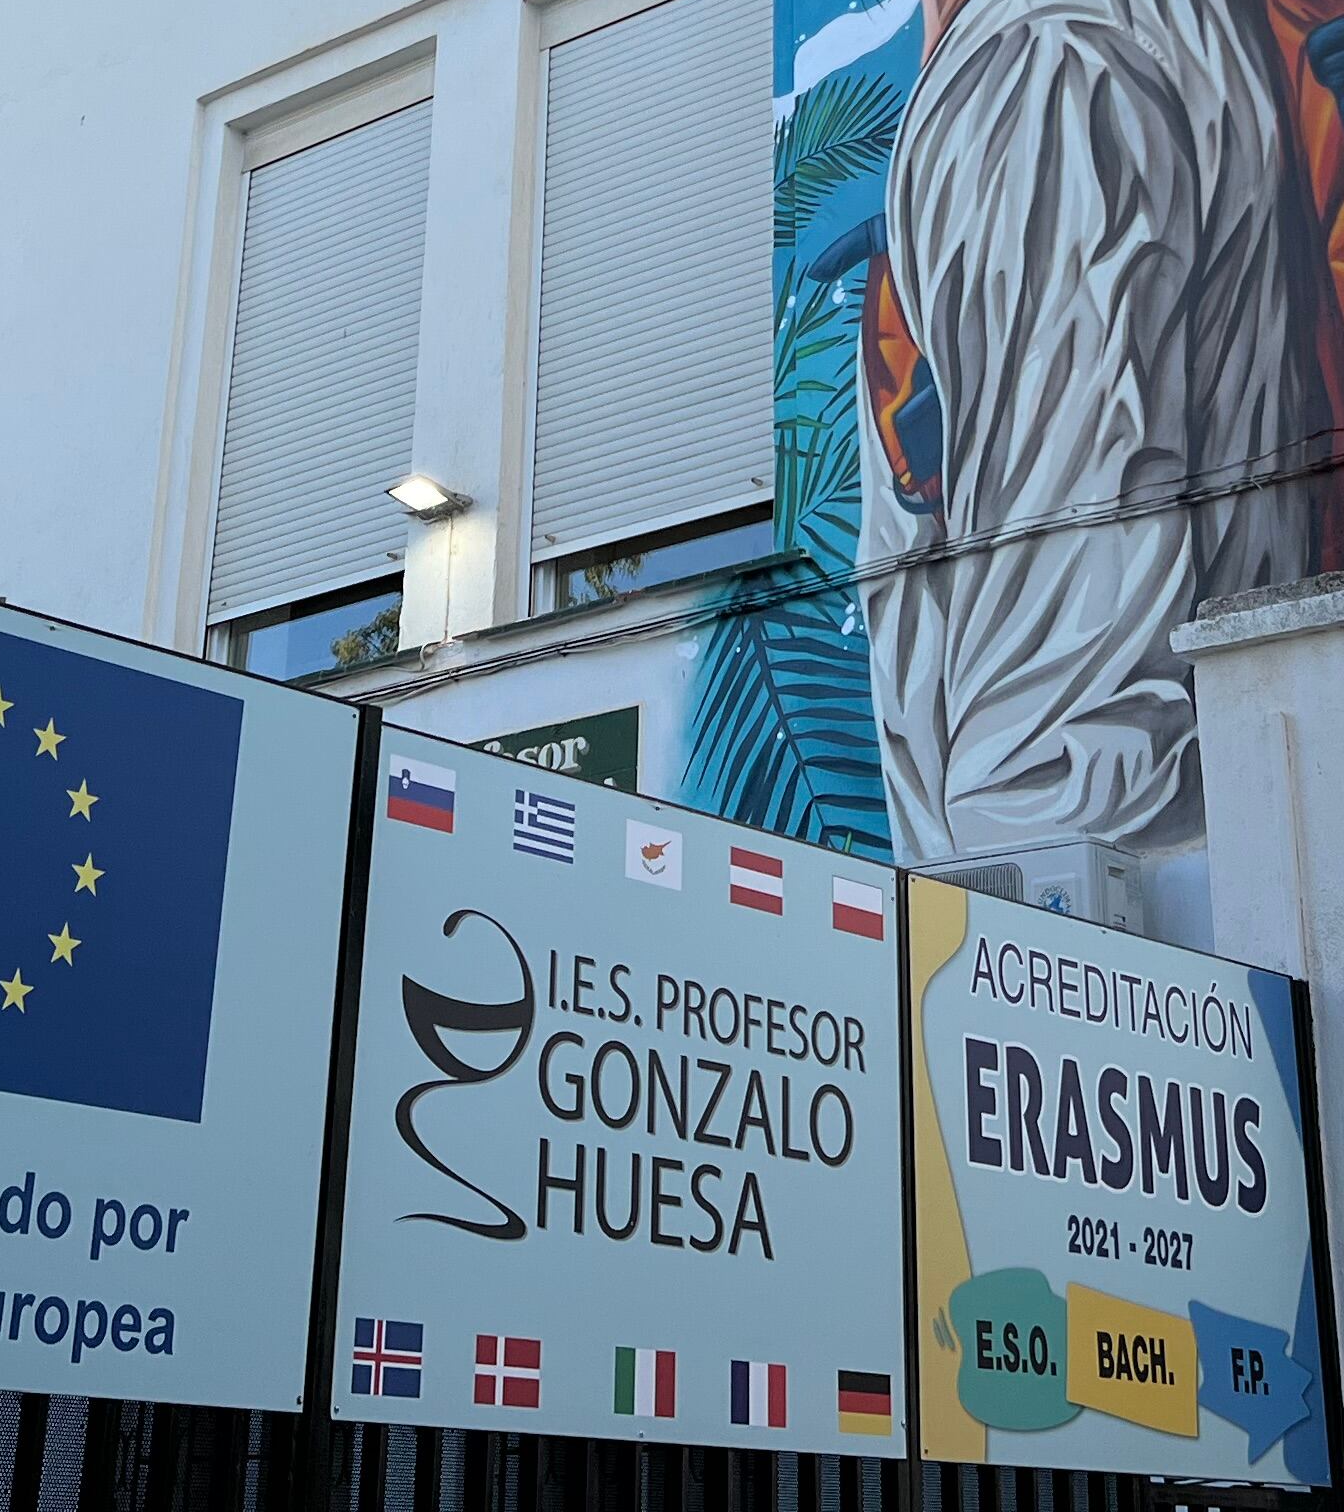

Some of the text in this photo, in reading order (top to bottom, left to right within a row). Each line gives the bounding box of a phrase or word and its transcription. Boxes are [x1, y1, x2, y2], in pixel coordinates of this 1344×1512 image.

[548, 949, 866, 1074] I.E.S. PROFESOR
[970, 936, 1254, 1060] ACREDITACIÓN
[538, 1031, 855, 1167] GONZALO
[962, 1033, 1268, 1216] ERASMUS
[89, 1196, 190, 1261] por
[536, 1137, 775, 1261] HUESA
[1067, 1214, 1120, 1260] 2021
[1143, 1226, 1193, 1272] 2027
[975, 1319, 1270, 1396] E.S.O. BACH. F.P.
